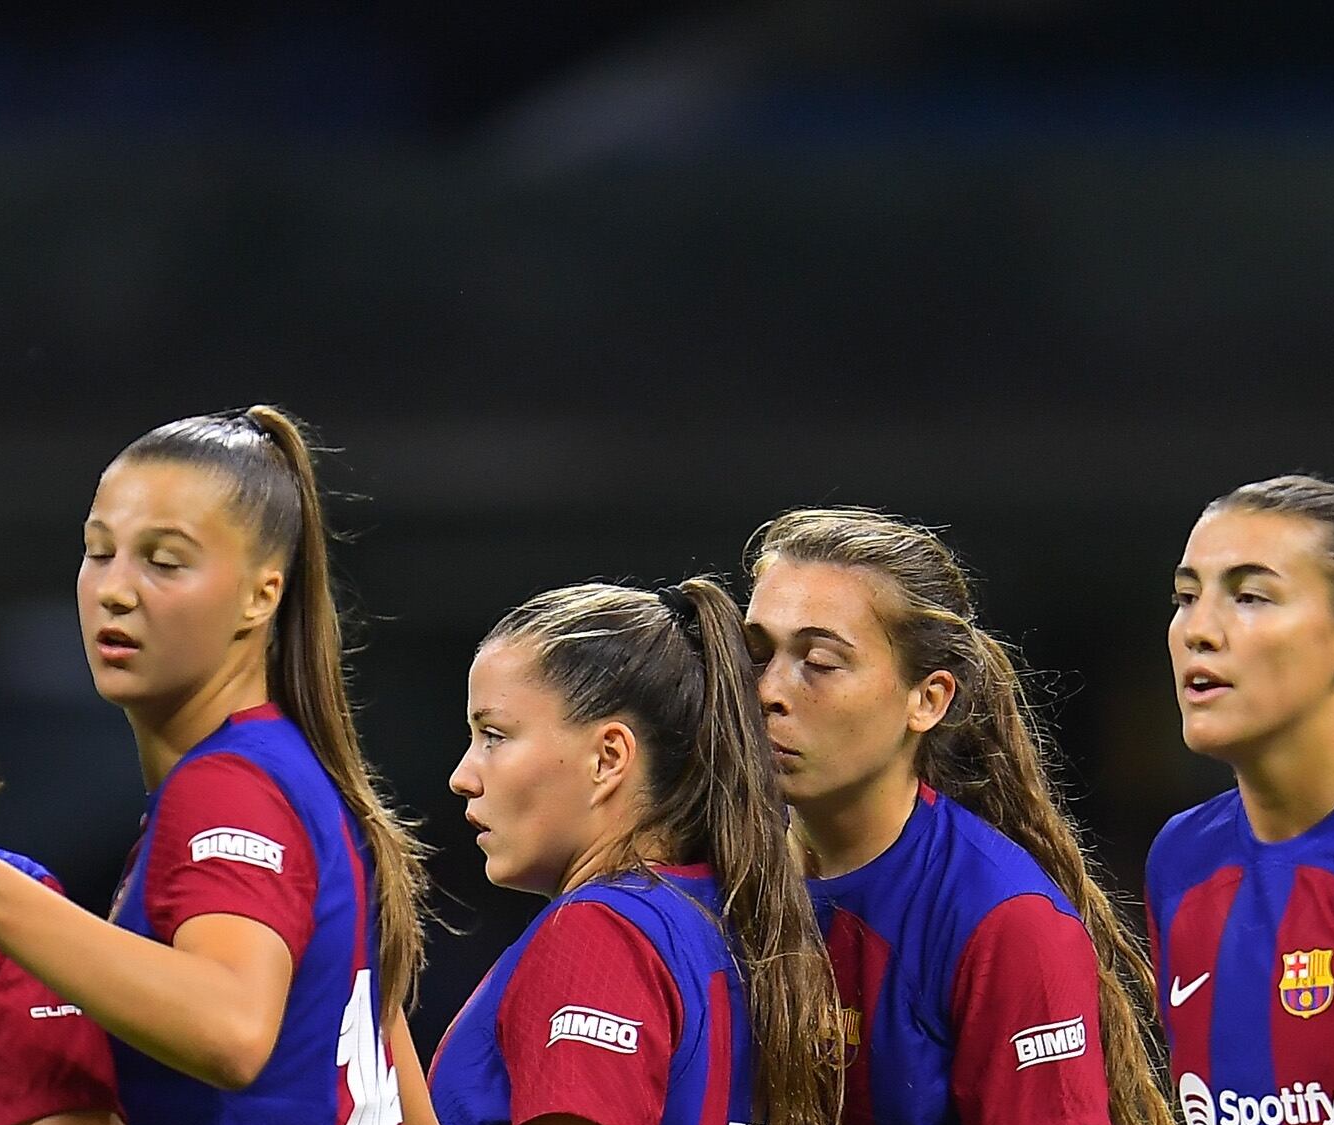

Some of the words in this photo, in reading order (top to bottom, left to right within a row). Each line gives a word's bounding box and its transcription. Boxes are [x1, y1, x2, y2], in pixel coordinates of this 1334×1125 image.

[191, 832, 283, 868] BIMBO
[549, 1012, 638, 1049] BIMBO
[1015, 1022, 1086, 1062] BIMBO
